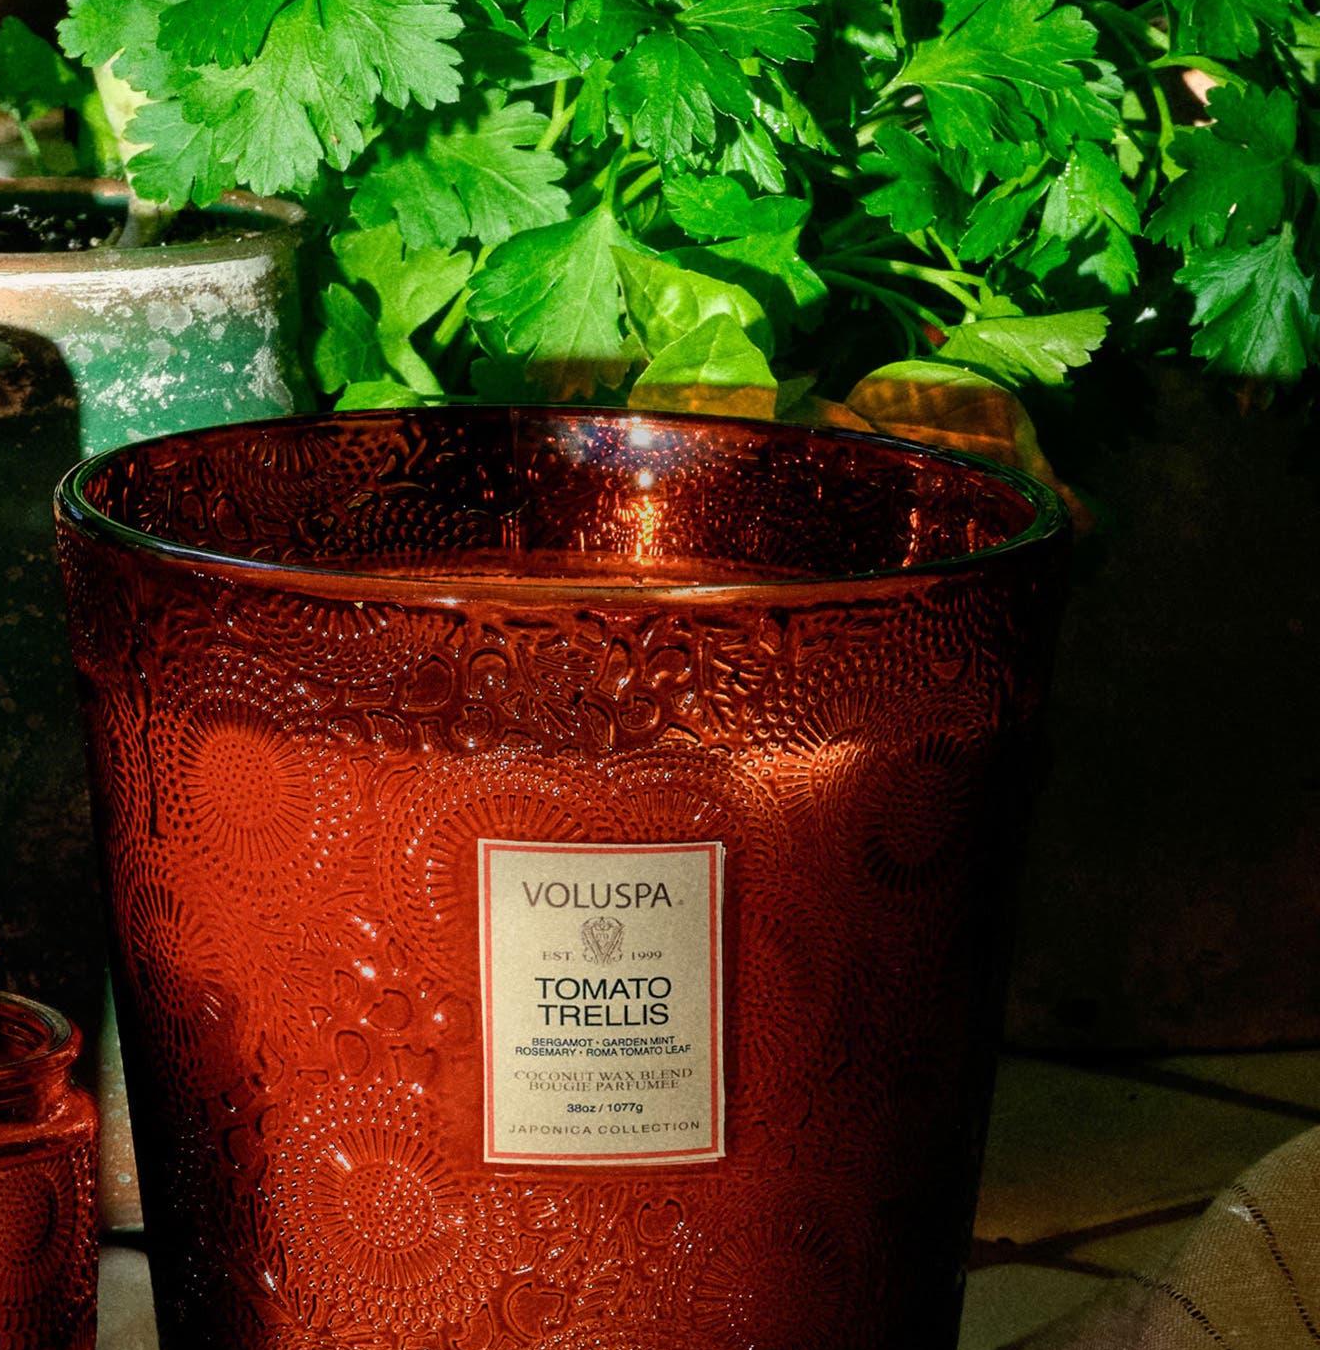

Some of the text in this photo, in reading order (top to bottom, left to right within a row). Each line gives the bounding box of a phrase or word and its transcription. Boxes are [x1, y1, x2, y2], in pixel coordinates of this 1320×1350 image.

[522, 881, 673, 908] VOLUSPA
[631, 951, 662, 961] 1999
[534, 977, 672, 1000] TOMATO
[537, 1003, 669, 1027] TRELLIS
[532, 1036, 675, 1048] BERGAMOT GARDEN MINT
[515, 1044, 691, 1057] ROSEMARY ROMA TOMATO LEAF
[514, 1068, 693, 1082] COCONUT WAX BLEND
[529, 1079, 679, 1092] BOUGIE PARFUMEE
[567, 1103, 596, 1113] 38oz
[607, 1103, 643, 1114] 1077g
[509, 1121, 700, 1135] JAPONICA COLLECTION
